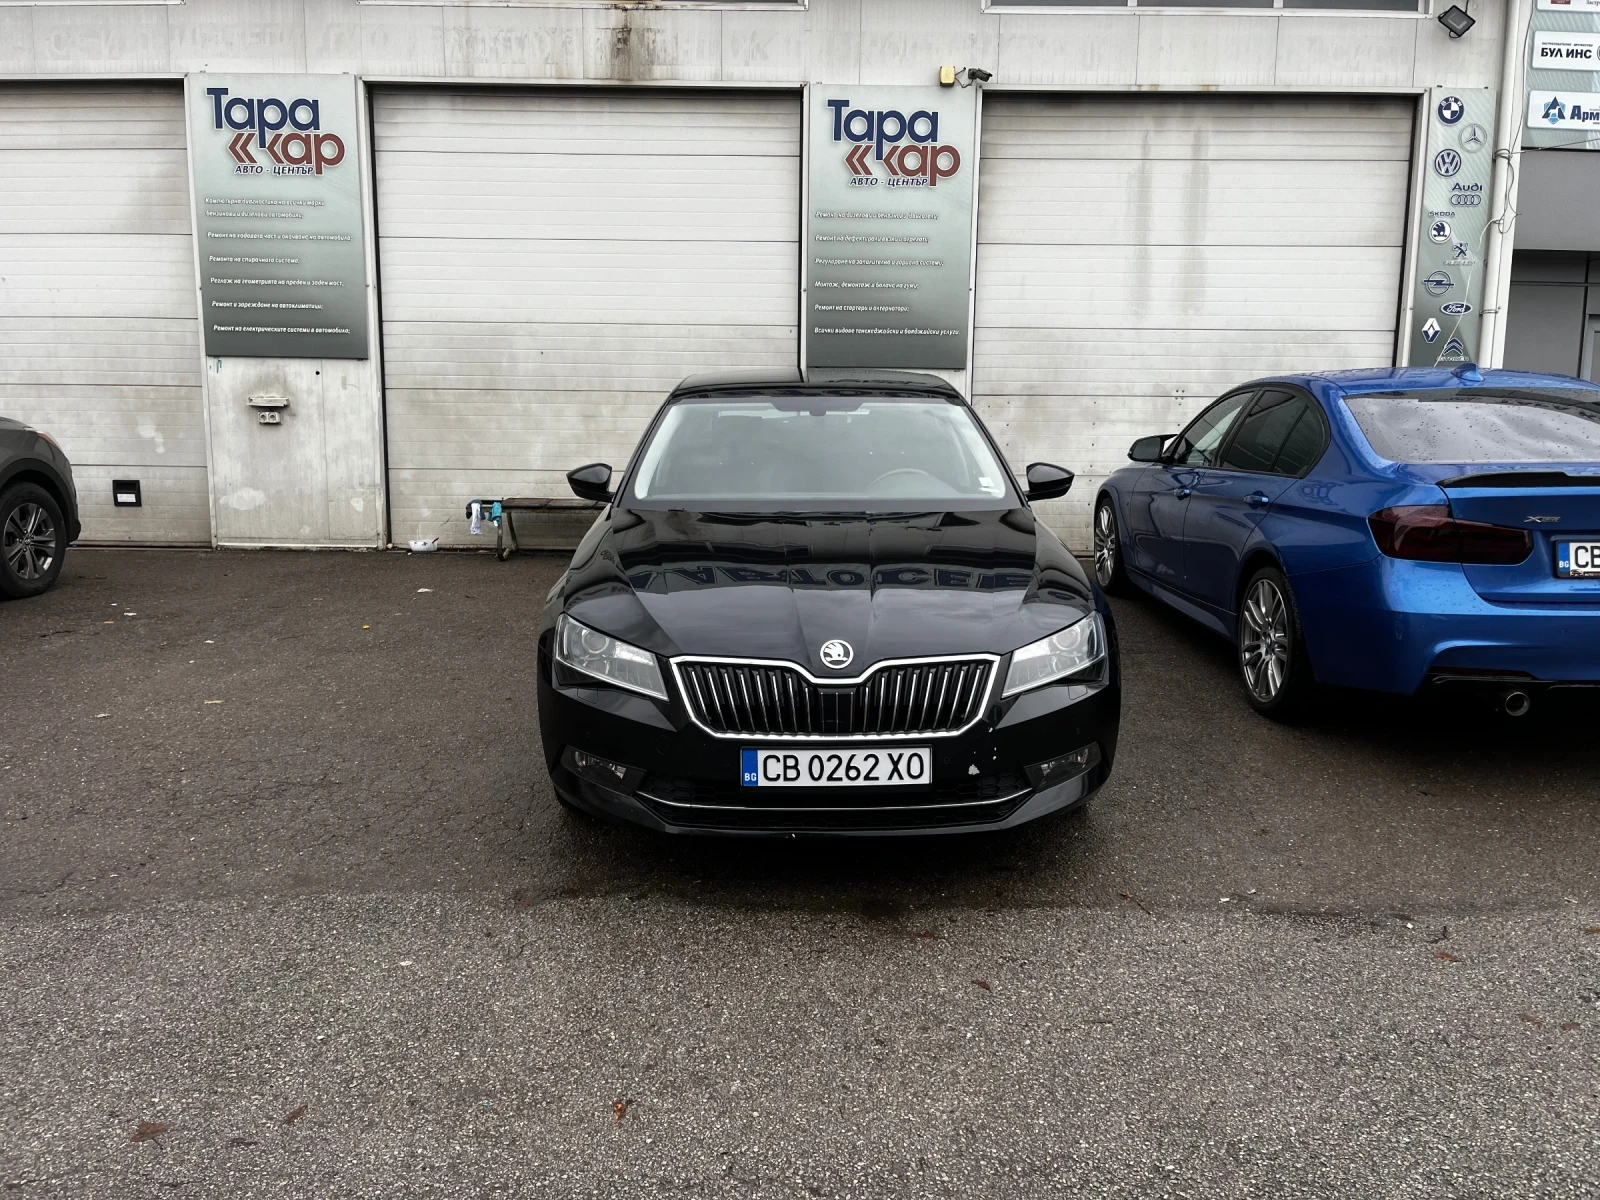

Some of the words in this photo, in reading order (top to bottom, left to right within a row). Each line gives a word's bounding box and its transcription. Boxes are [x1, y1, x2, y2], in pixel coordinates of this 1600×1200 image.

[1541, 47, 1563, 58] БУЛ
[1566, 48, 1592, 59] ИНС
[206, 87, 320, 149] Тара
[827, 99, 939, 161] Тара
[235, 165, 263, 174] АВТО
[273, 165, 314, 175] ЦЕНТЪР
[849, 177, 878, 186] АВТО
[887, 178, 928, 188] ЦЕНТЪР
[1451, 182, 1483, 192] Audi
[207, 231, 228, 239] Ремонт
[763, 754, 801, 782] CB
[808, 754, 880, 782] 0262
[887, 752, 924, 780] XO
[744, 773, 757, 781] BG
